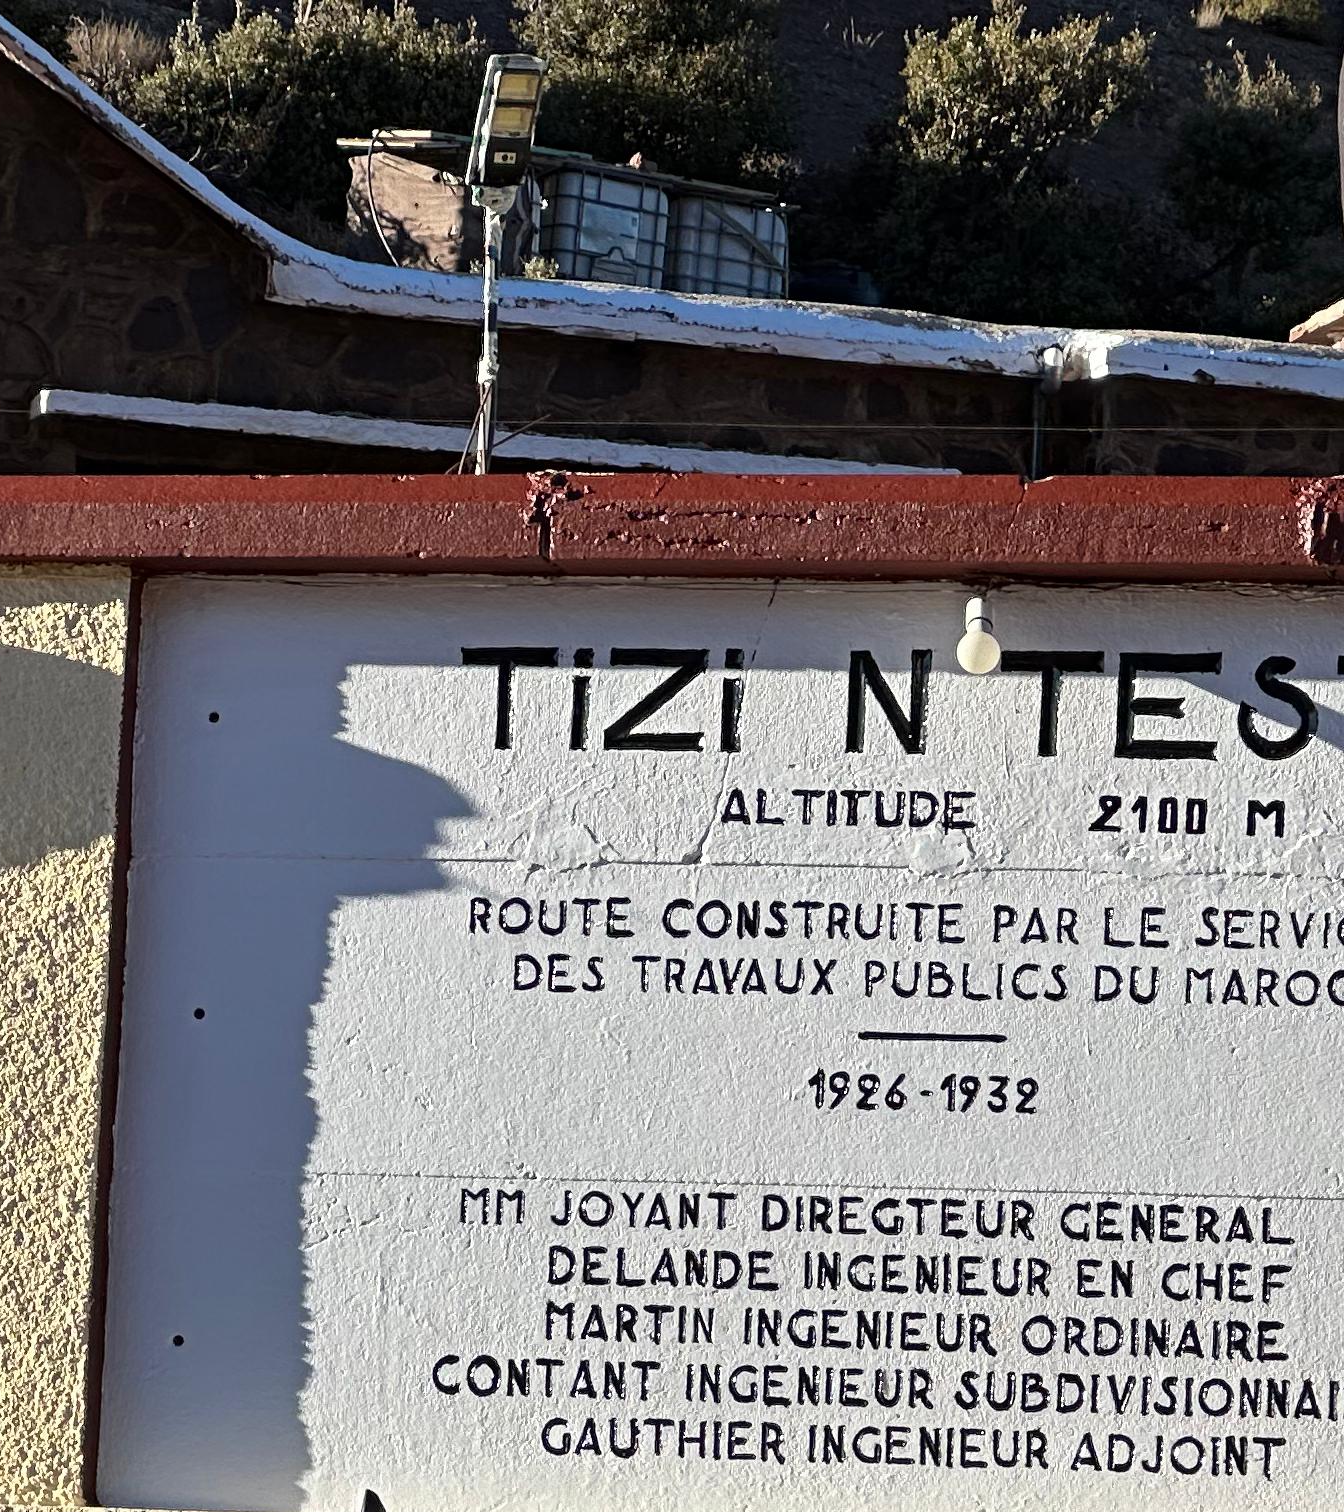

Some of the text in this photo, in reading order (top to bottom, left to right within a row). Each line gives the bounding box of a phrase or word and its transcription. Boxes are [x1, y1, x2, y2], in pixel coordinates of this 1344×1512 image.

[845, 649, 933, 755] N
[721, 788, 1285, 838] ALTITUDE 2100 M
[470, 897, 634, 938] ROUTE
[662, 899, 965, 943] CONSTRUITE
[993, 905, 1078, 944] PAR
[1104, 908, 1169, 948] LE
[514, 954, 605, 992] DES
[632, 956, 836, 995] TRAVAUX
[865, 961, 1067, 1001] PUBLICS
[1095, 966, 1158, 1004] DU
[460, 1188, 524, 1225] MM
[551, 1191, 736, 1230] JOYANT
[1061, 1201, 1295, 1245] GENERAL
[548, 1246, 1292, 1304] DELANDE INGENIEUR EN CHEF
[546, 1301, 1288, 1363] MARTIN INGENIEUR ORDINAIRE
[433, 1355, 660, 1401] CONTANT
[686, 1364, 933, 1409] INGENIEUR
[542, 1418, 1286, 1481] GAUTHIER INGENIEUR ADJOINT
